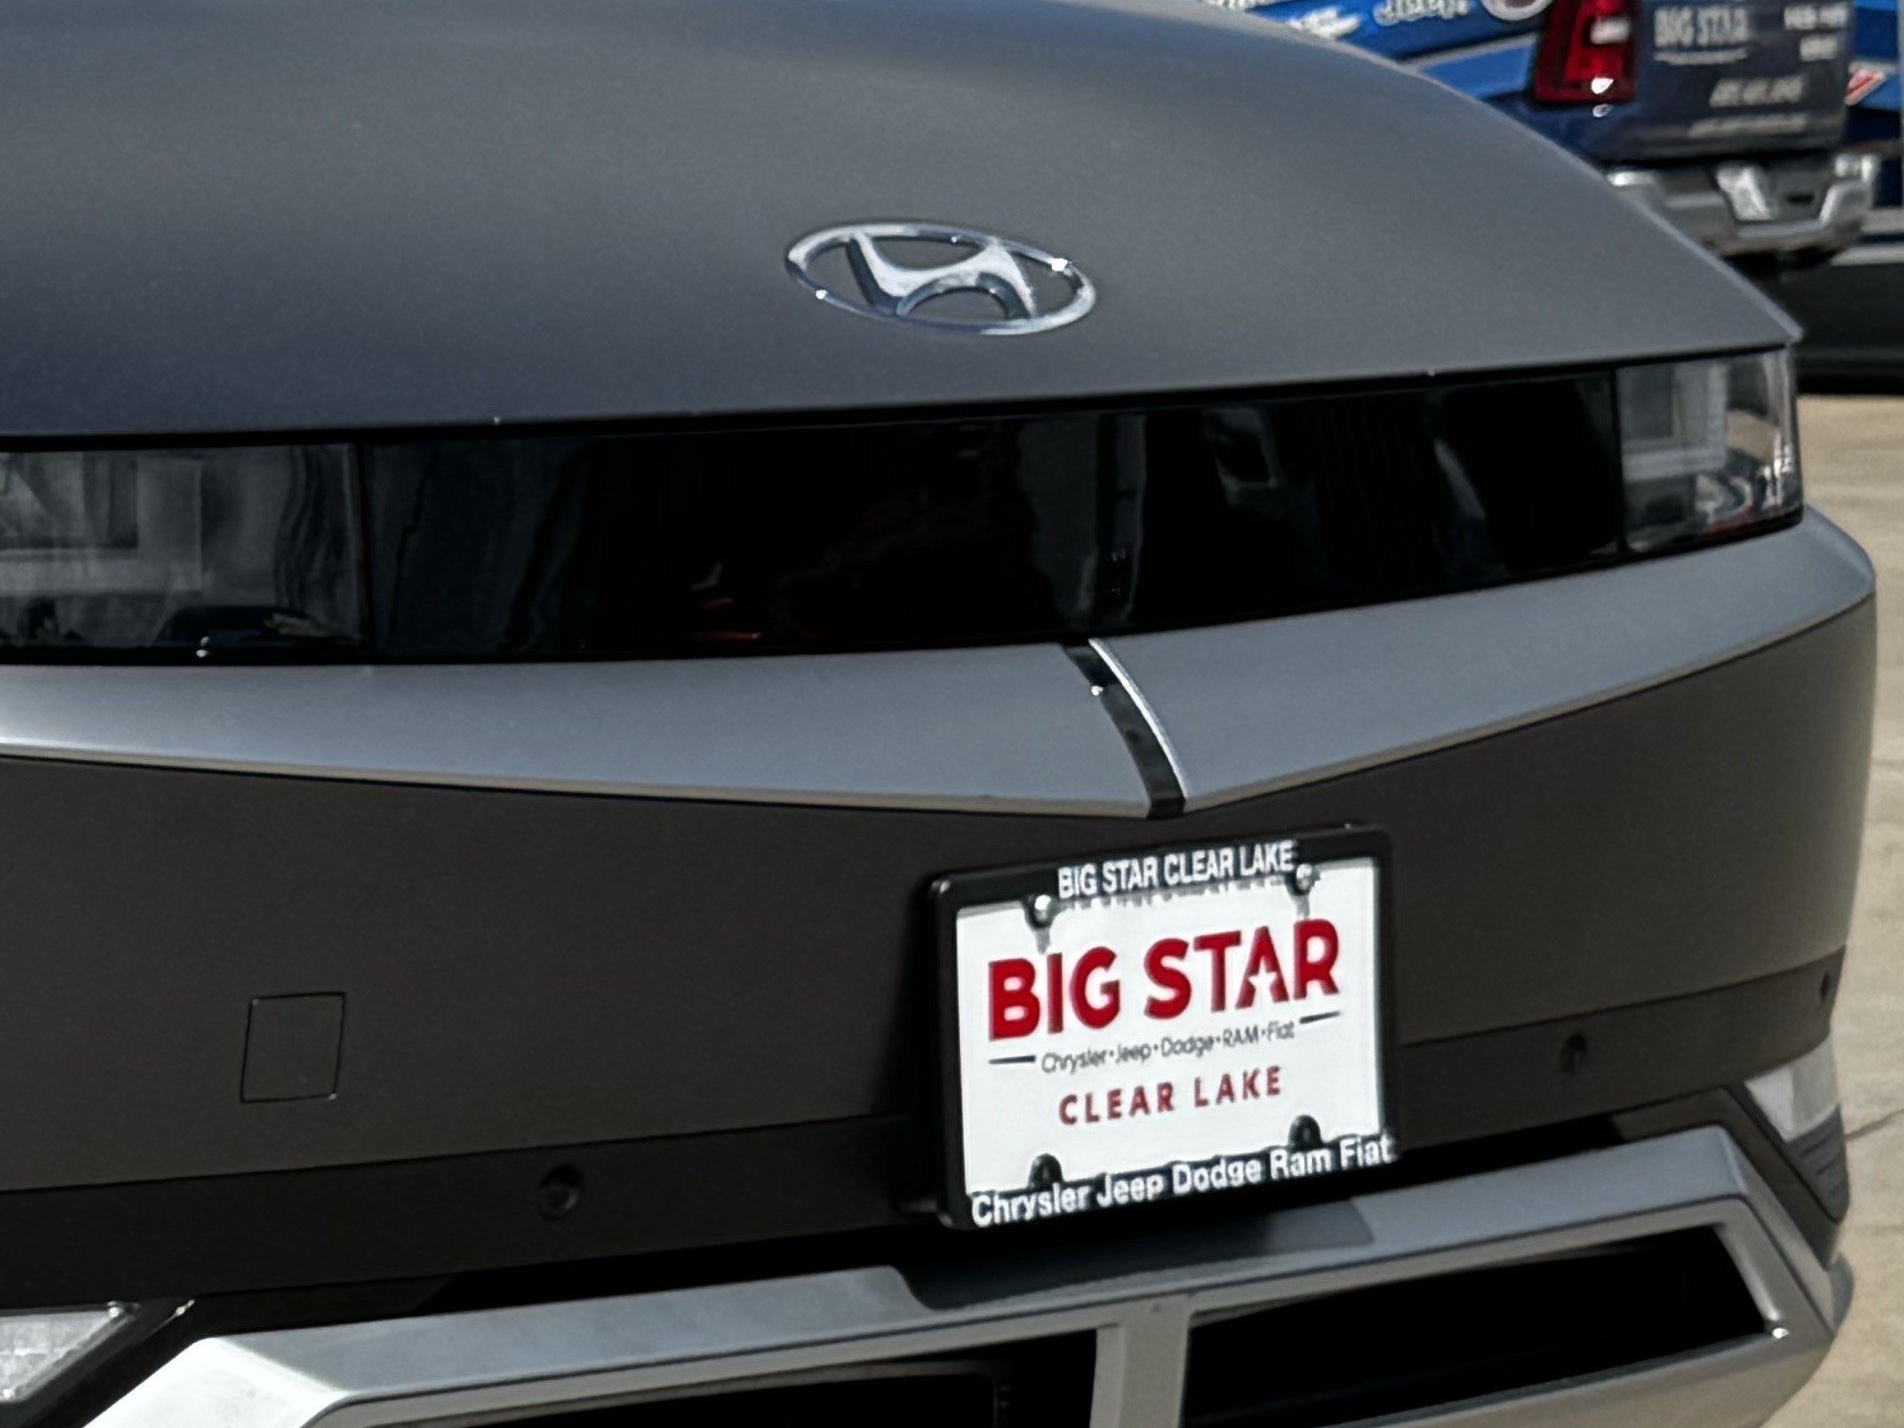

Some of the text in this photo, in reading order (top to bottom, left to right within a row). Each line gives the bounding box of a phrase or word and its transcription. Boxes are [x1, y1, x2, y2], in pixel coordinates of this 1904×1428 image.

[1058, 839, 1294, 899] BIG STAR CLEAR LAKE
[987, 918, 1341, 1042] BIG STAR
[1041, 1019, 1295, 1074] Chrysler Jeep Dodge RAM Fiat
[1058, 1064, 1282, 1126] CLEAR LAKE
[971, 1133, 1395, 1229] Chrysler Jeep Dodge Ram Fiat
